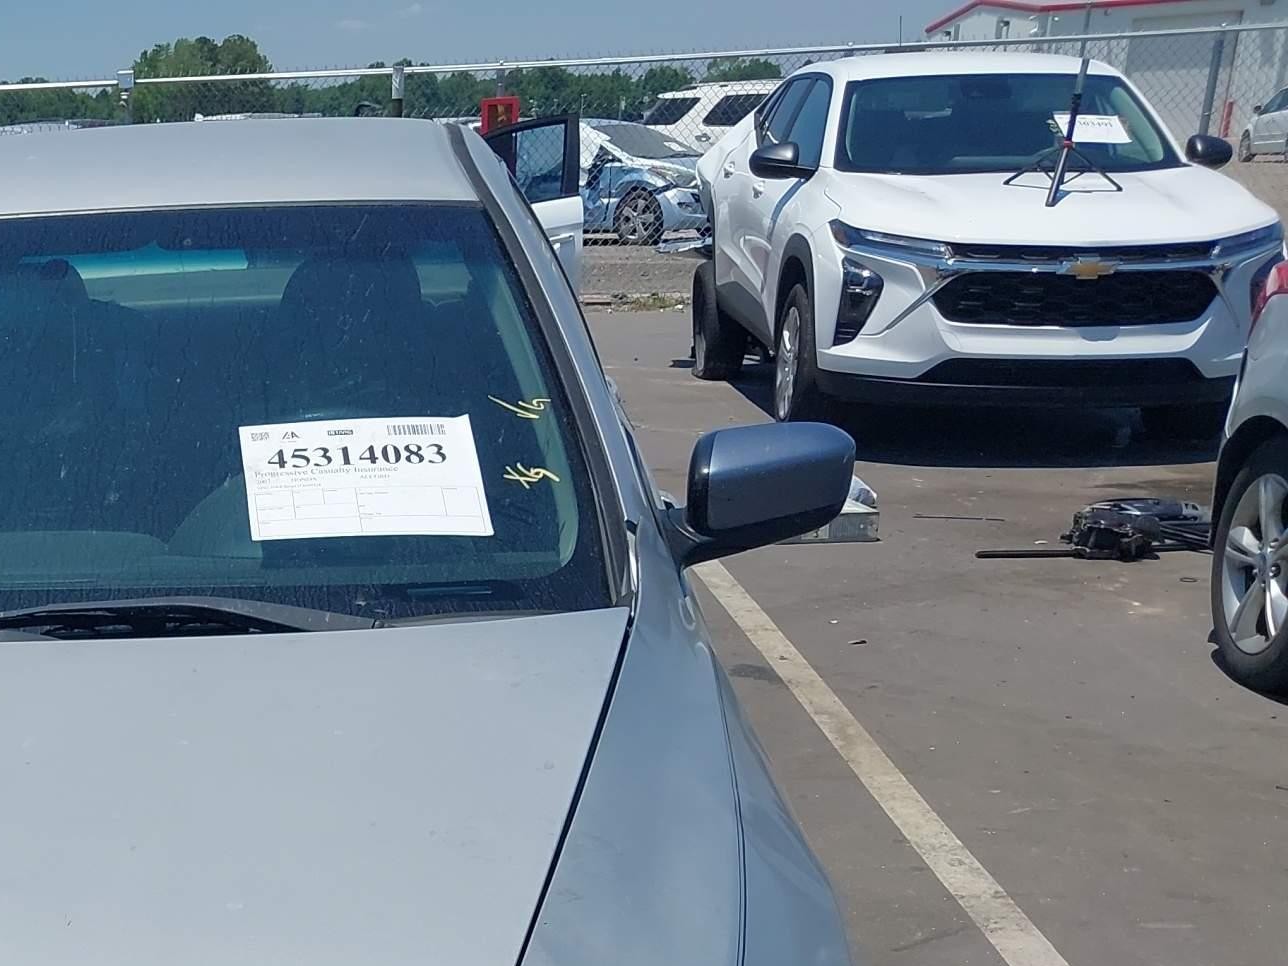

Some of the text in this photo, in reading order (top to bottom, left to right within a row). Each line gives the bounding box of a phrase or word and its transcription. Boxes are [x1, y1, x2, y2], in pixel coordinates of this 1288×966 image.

[267, 443, 448, 470] 45314083
[254, 470, 308, 479] Progressive
[310, 467, 351, 476] Casualty
